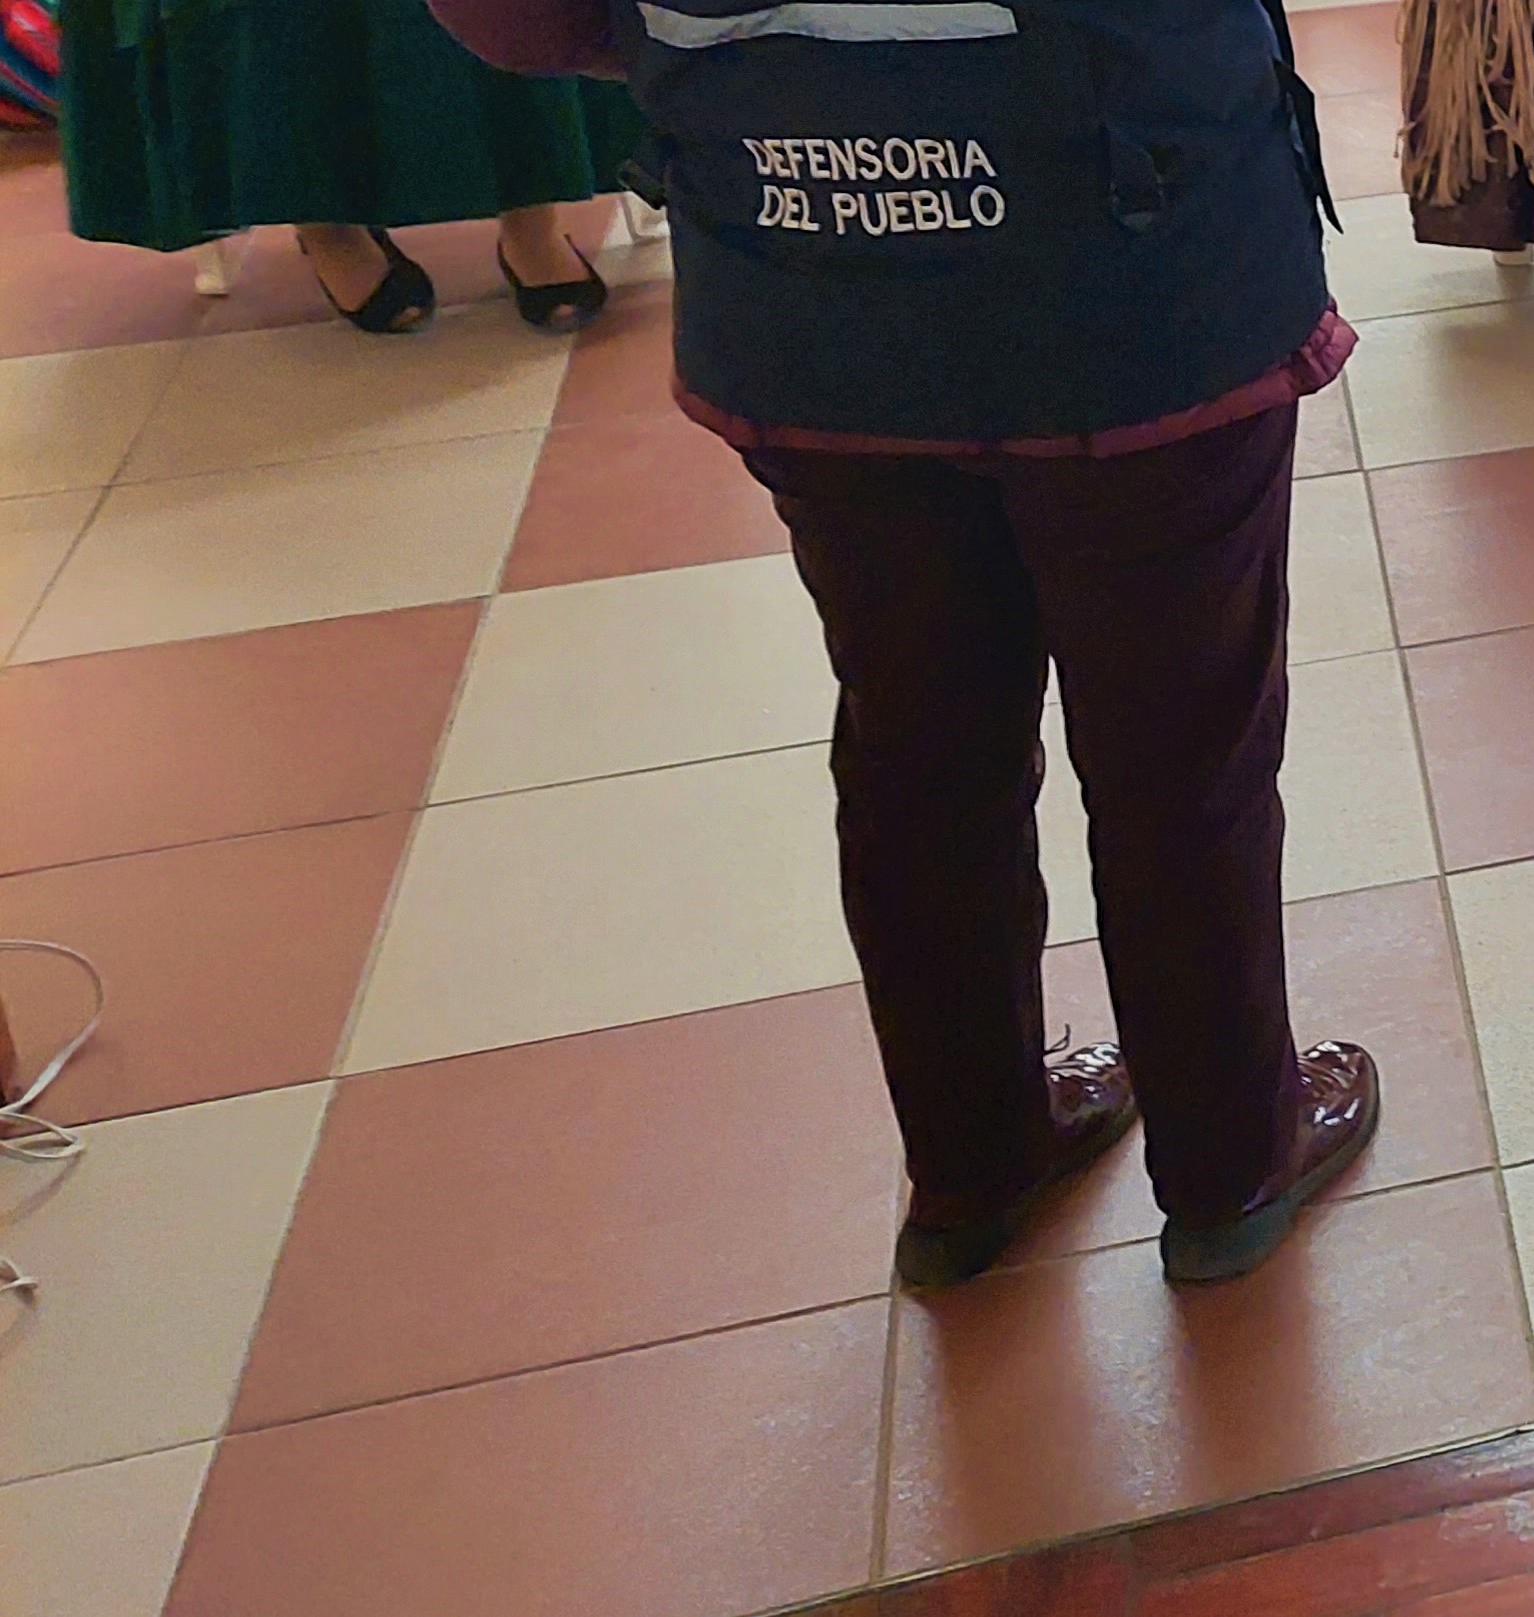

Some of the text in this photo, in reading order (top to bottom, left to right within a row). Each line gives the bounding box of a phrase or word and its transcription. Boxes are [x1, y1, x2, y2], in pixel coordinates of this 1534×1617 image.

[742, 137, 997, 180] DEFENSORIA
[757, 185, 1004, 235] DEL PUEBLO
